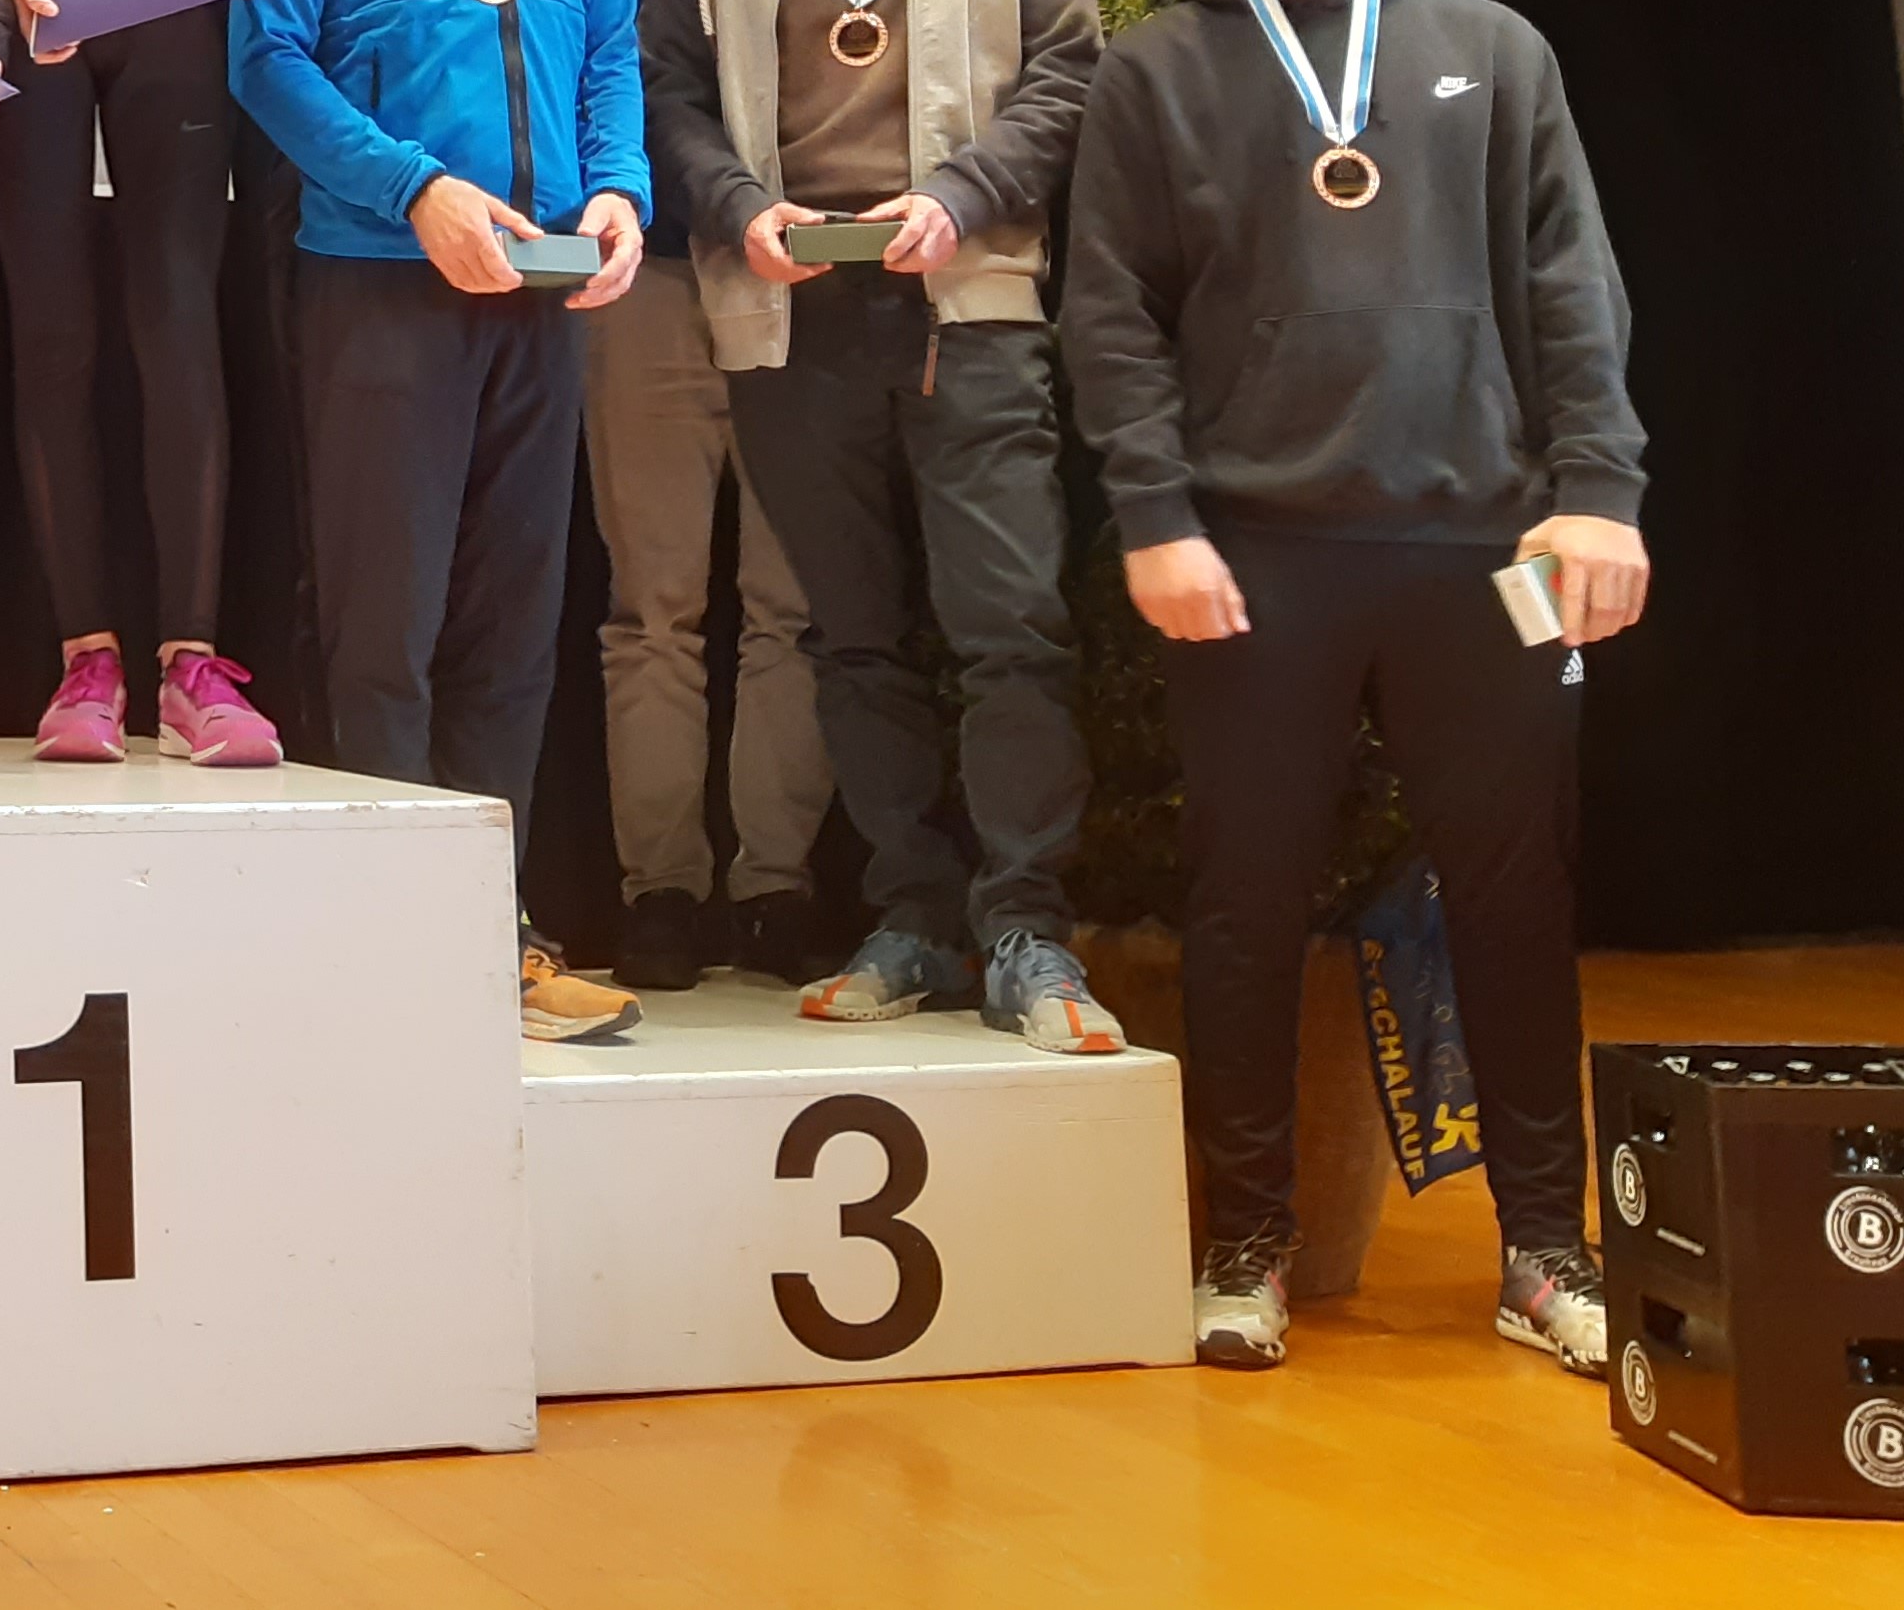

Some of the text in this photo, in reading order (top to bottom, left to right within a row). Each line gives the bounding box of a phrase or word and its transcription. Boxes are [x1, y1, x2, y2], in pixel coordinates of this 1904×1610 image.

[14, 993, 135, 1281] 1
[772, 1094, 942, 1361] 3
[1857, 1211, 1884, 1245] B
[1877, 1423, 1904, 1459] B
